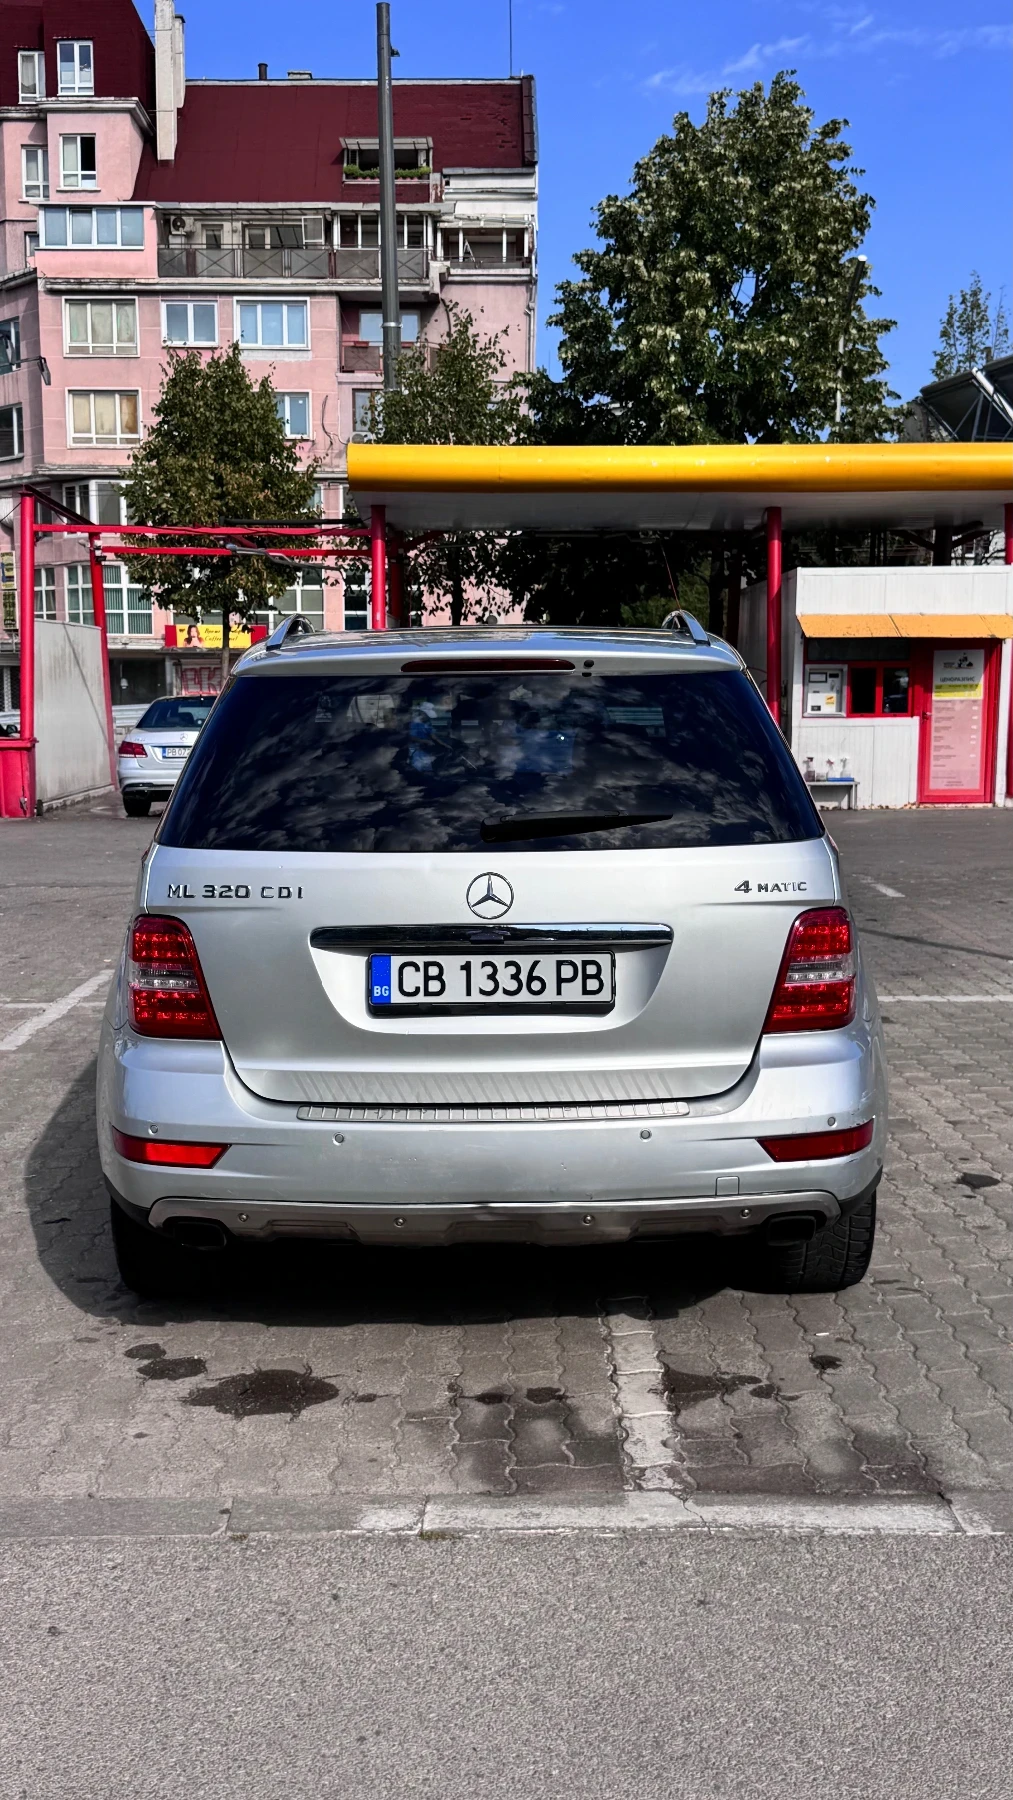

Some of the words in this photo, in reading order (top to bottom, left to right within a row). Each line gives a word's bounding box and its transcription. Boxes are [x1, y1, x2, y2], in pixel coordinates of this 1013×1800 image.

[177, 748, 191, 756] 072
[167, 884, 196, 898] ML
[202, 884, 251, 899] 320
[260, 886, 303, 899] CDI
[734, 880, 752, 893] 4
[757, 882, 807, 892] MATIC
[398, 960, 446, 997] CB
[460, 960, 547, 996] 1336
[556, 959, 605, 996] PB
[373, 985, 389, 997] BG
